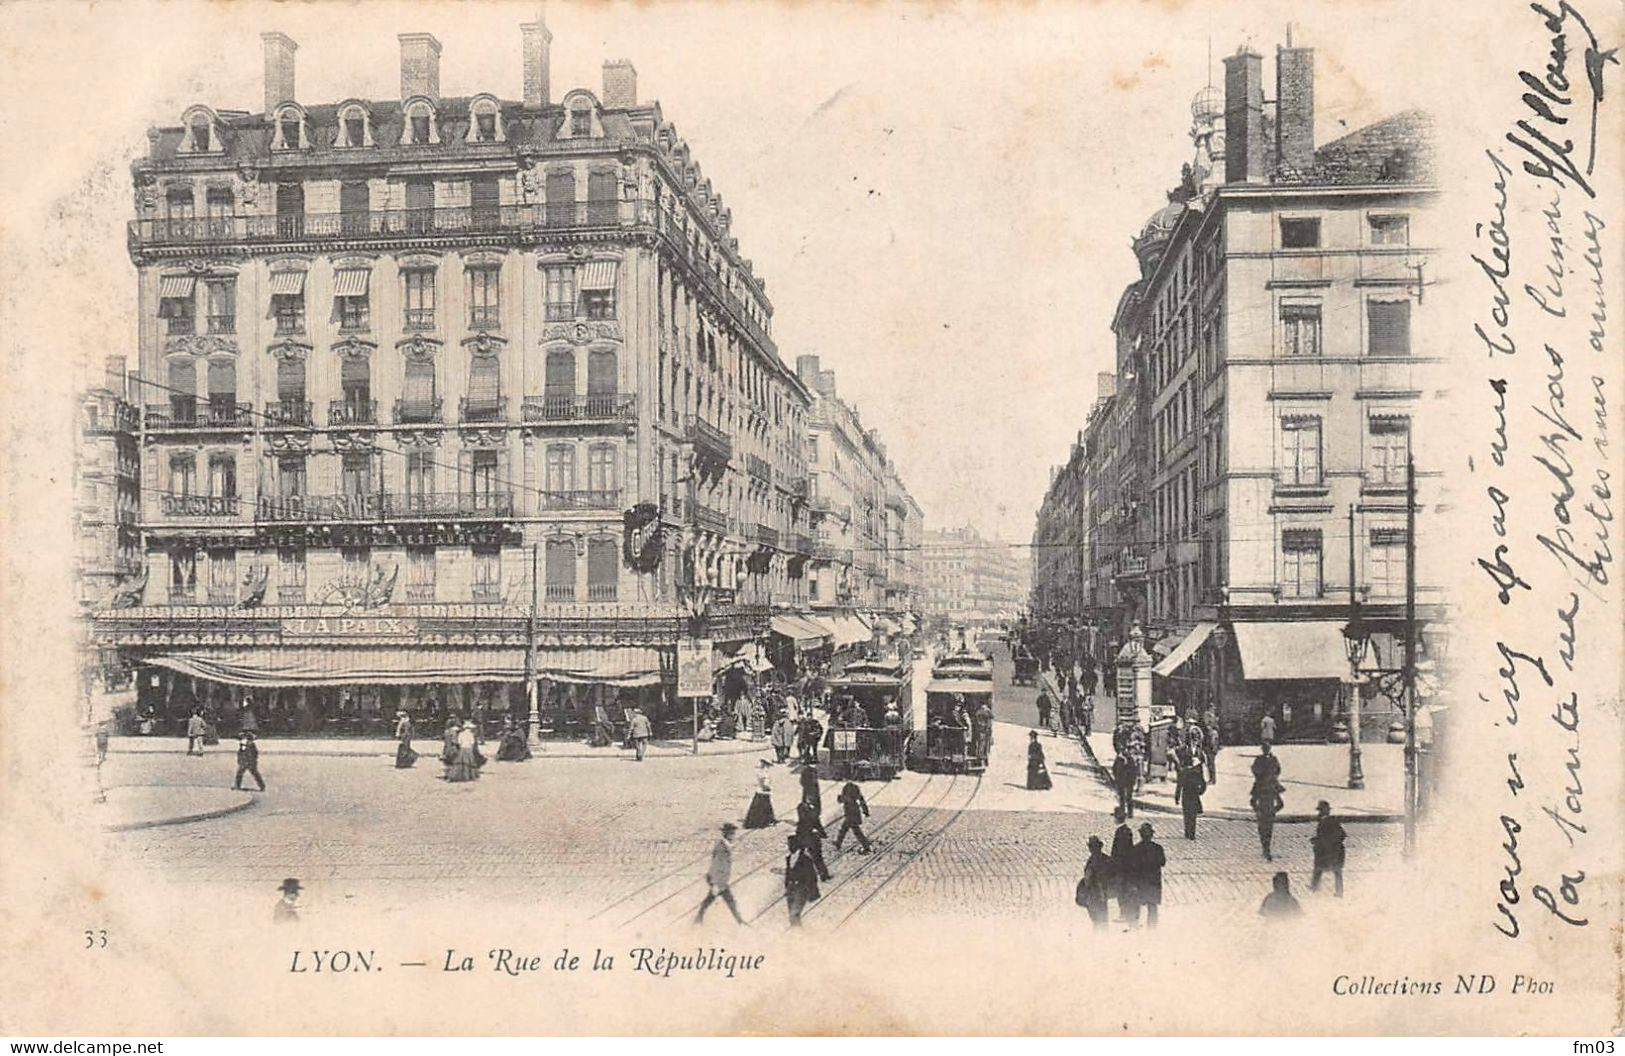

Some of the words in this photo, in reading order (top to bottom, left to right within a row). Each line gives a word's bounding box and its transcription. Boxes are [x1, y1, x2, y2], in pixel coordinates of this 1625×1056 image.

[1523, 183, 1568, 319] lundi
[396, 532, 498, 546] RESTAURANT
[300, 619, 331, 634] LA
[340, 619, 401, 634] PAIX
[1540, 691, 1588, 849] tante
[1491, 815, 1522, 939] vous
[1531, 870, 1589, 927] la
